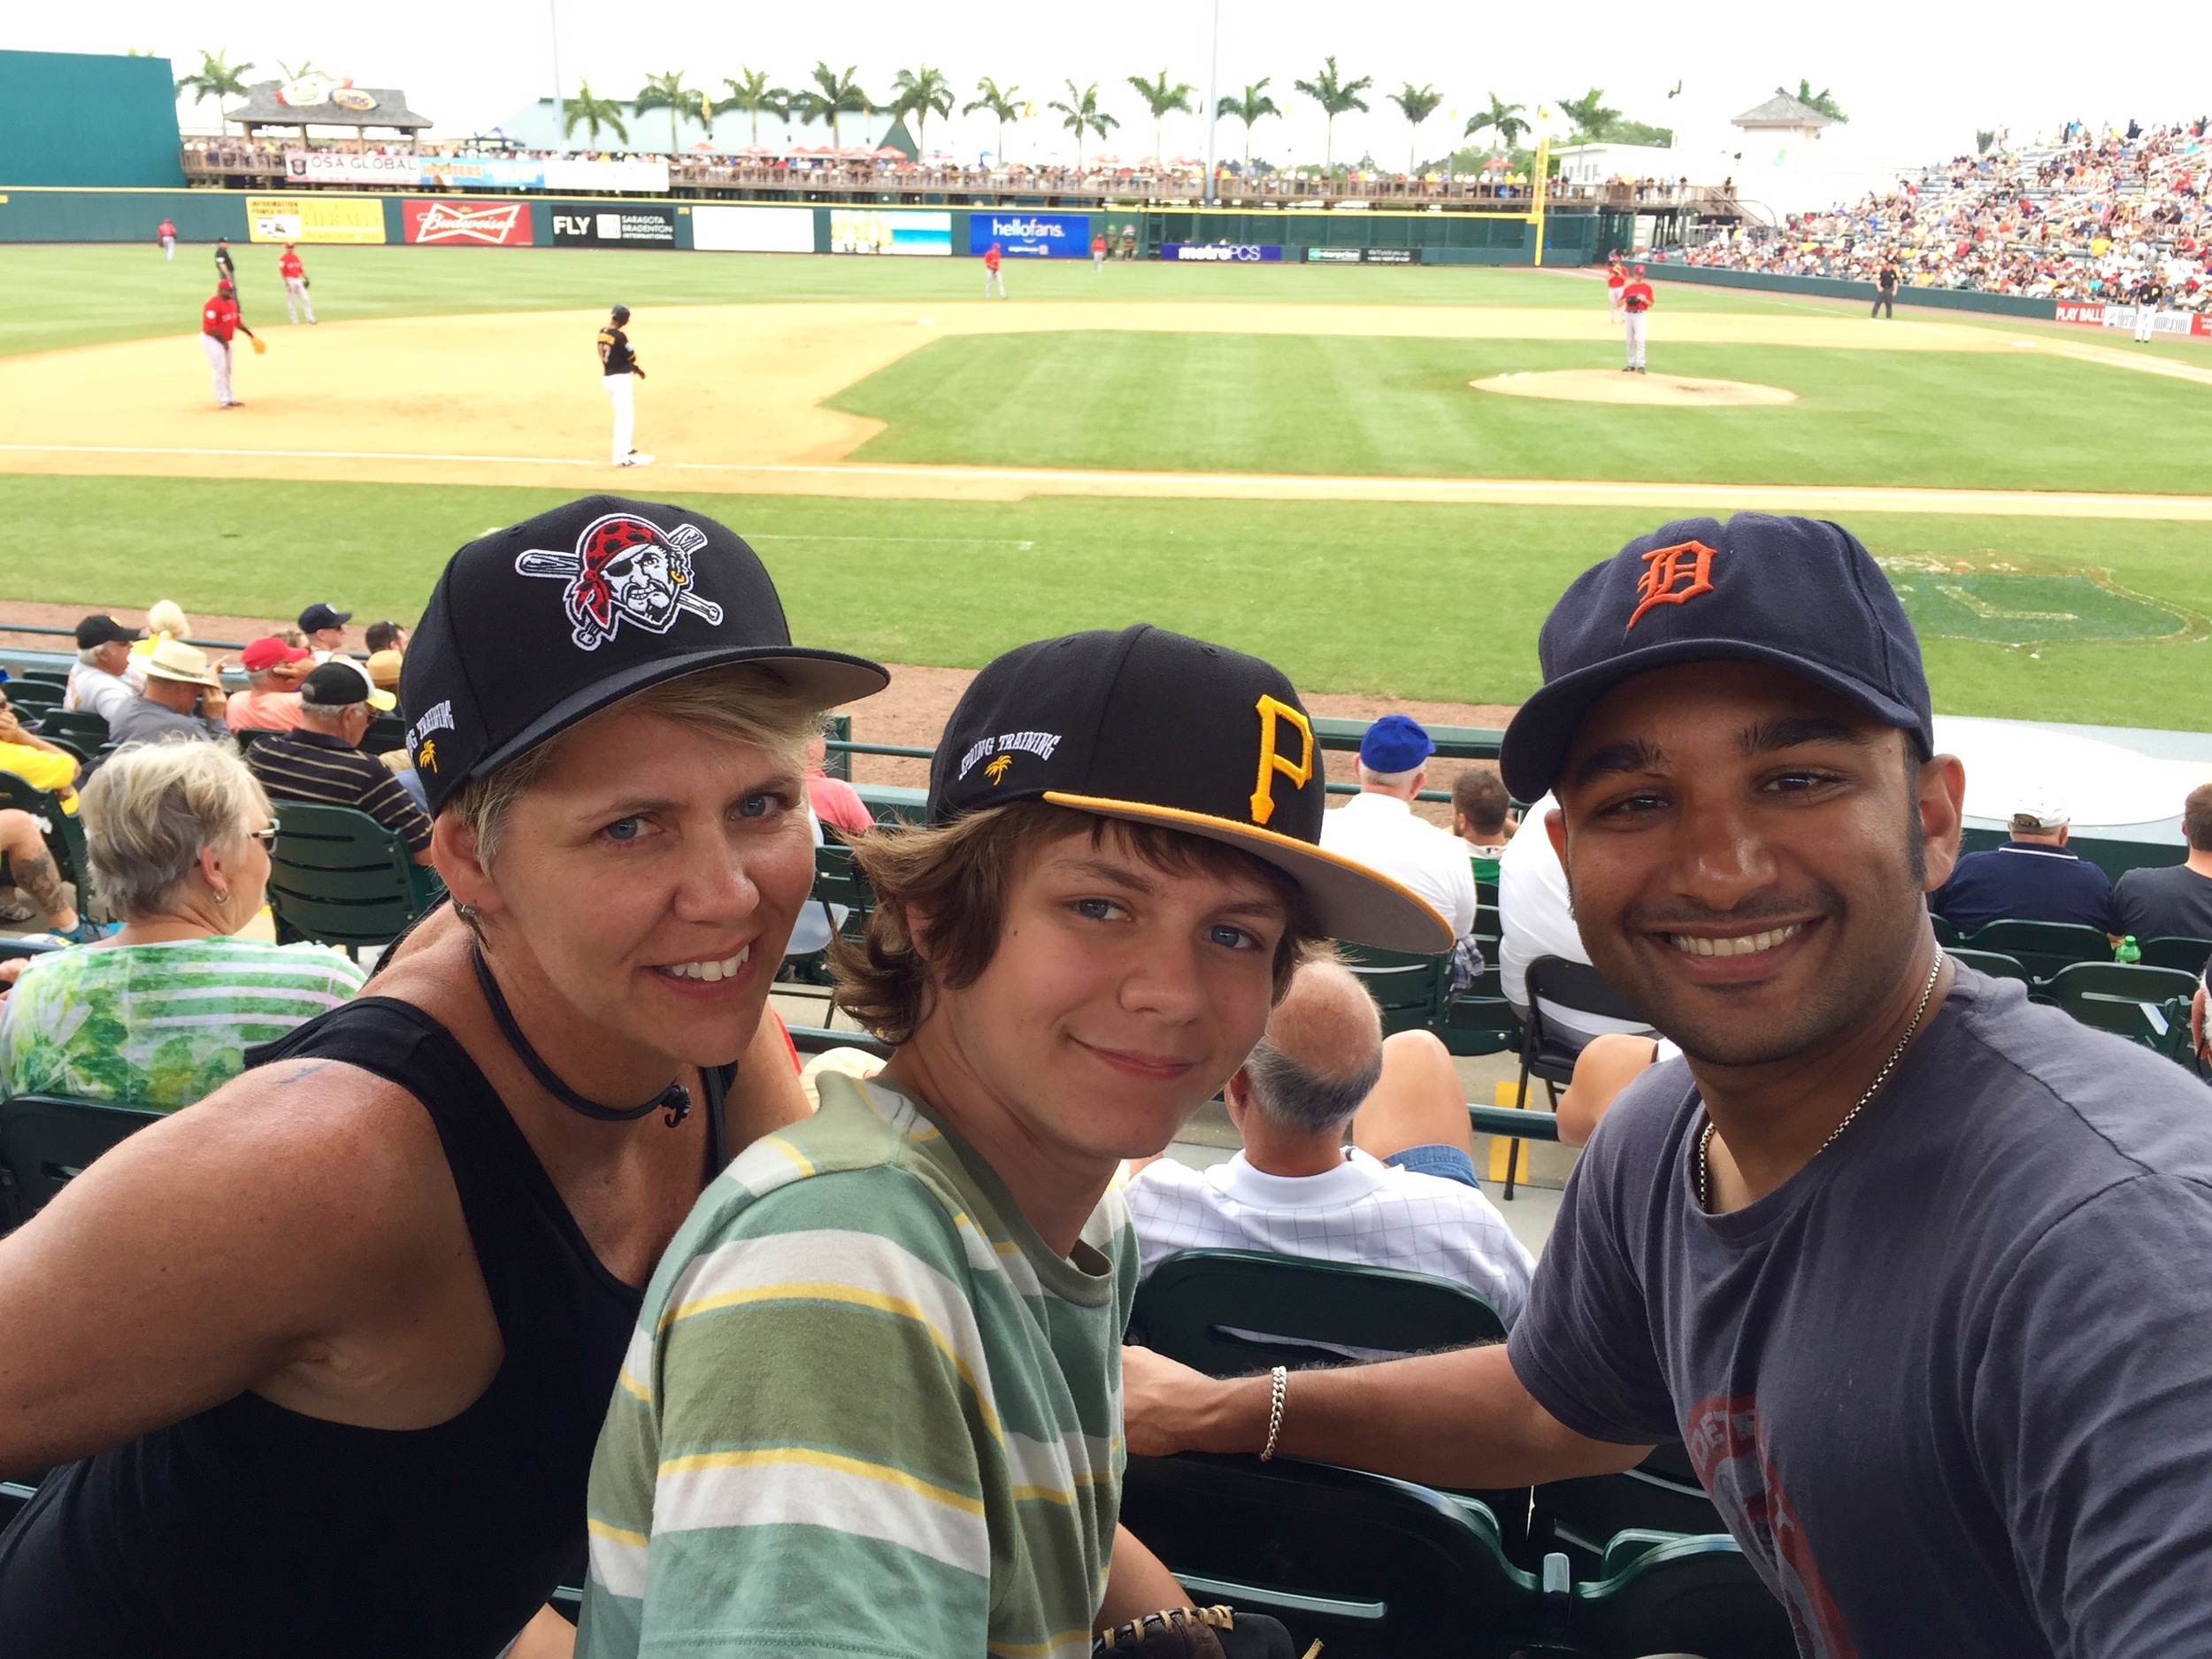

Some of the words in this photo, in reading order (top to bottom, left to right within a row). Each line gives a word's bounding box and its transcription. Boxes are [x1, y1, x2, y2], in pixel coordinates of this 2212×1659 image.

[311, 156, 345, 168] OSA
[350, 157, 418, 171] GLOBAL
[416, 212, 516, 231] Budweiser
[553, 216, 591, 234] FLY
[621, 215, 665, 224] SARASOTA
[1179, 244, 1261, 260] metroPCS
[2055, 307, 2078, 321] PLAY
[958, 736, 995, 781] SPRING
[996, 731, 1062, 761] TRAINING
[1249, 694, 1314, 825] P
